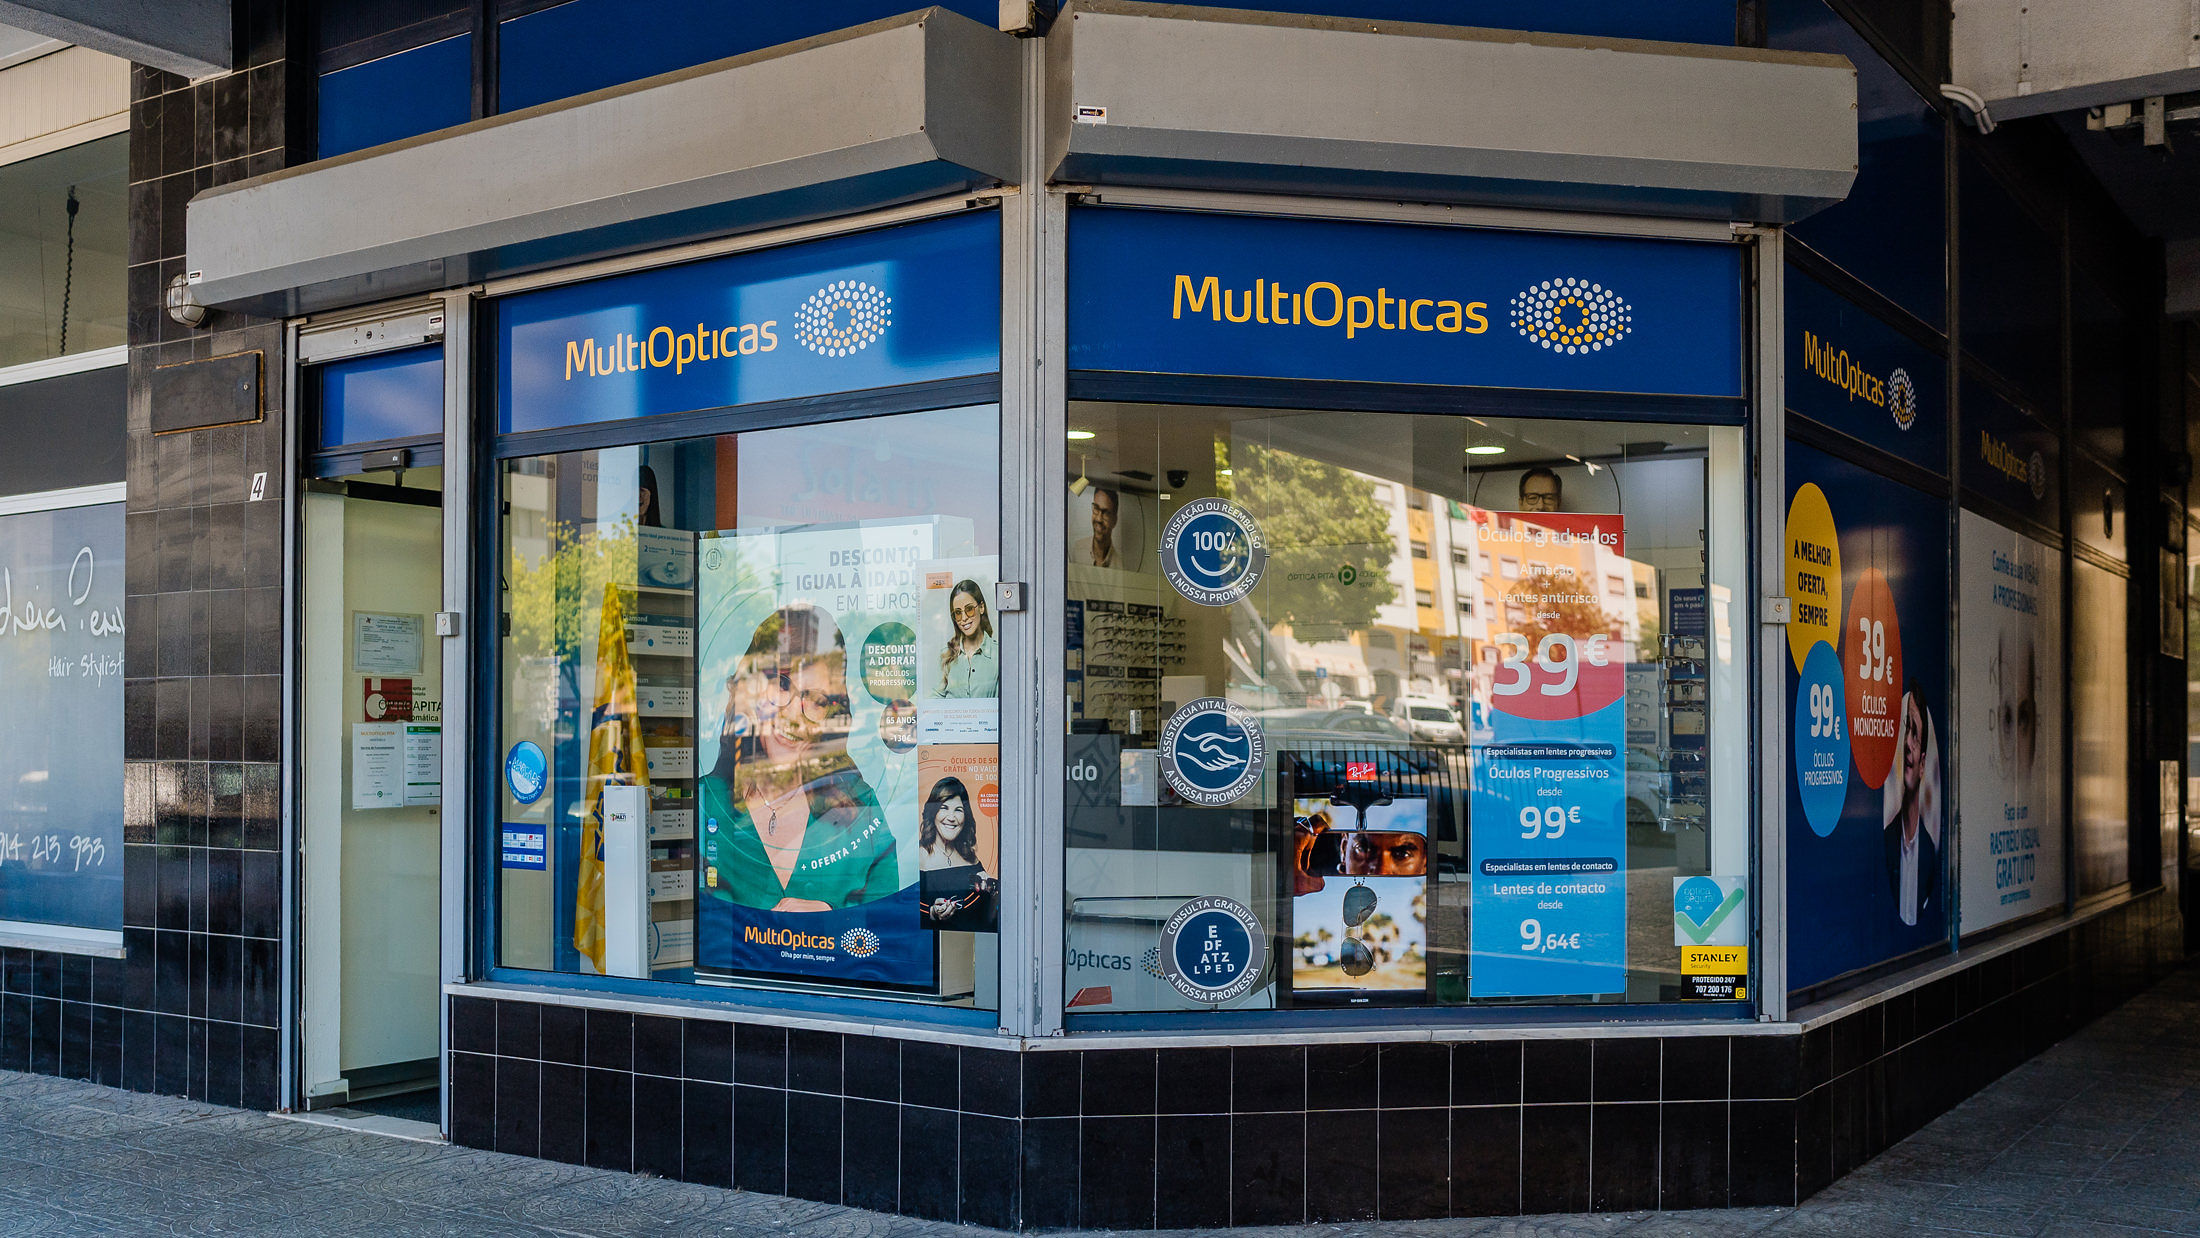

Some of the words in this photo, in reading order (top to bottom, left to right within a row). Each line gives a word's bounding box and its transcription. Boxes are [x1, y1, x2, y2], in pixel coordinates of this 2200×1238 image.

[1173, 274, 1489, 339] MultiOpticas
[565, 320, 778, 381] MultiOpticas
[1804, 330, 1885, 408] MultiOpticas
[1981, 430, 2028, 484] MultiOpticas
[252, 476, 264, 498] 4
[1165, 501, 1204, 549] SATISFAÇÃO
[1206, 502, 1220, 511] OU
[1221, 504, 1261, 549] REEMBOLSO
[1479, 523, 1531, 543] Óculos
[1534, 528, 1618, 548] graduados
[1192, 531, 1236, 551] 100%
[829, 546, 921, 567] DESCONTO
[1793, 539, 1801, 560] A
[1801, 541, 1832, 568] MELHOR
[796, 573, 847, 591] IGUAL
[851, 568, 863, 588] À
[1519, 563, 1574, 578] Armação
[1169, 572, 1178, 580] A
[1175, 578, 1207, 601] NOSSA
[1209, 572, 1258, 602] PROMESSA
[1798, 571, 1829, 601] OFERTA,
[836, 594, 860, 611] EM
[1498, 592, 1539, 604] Lentes
[1542, 591, 1599, 604] antirrisco
[1536, 611, 1561, 619] desde
[1798, 603, 1829, 628] SEMPRE
[868, 645, 916, 655] DESCONTO
[869, 657, 876, 665] A
[878, 656, 915, 666] DOBRAR
[49, 655, 74, 678] Hair
[80, 651, 125, 689] Stylist
[886, 668, 910, 677] ÓCULOS
[869, 679, 915, 687] PROGRESSIVOS
[1862, 691, 1888, 716] ÓCULOS
[896, 716, 916, 724] ANOS
[1853, 716, 1895, 739] MONOFOCAIS
[1163, 704, 1198, 759] ASSISTÊNCIA
[1198, 700, 1243, 718] VITALÍCIA
[1242, 717, 1263, 764] GRATUITA
[950, 756, 977, 764] ÓCULOS
[1486, 747, 1532, 757] Especialistas
[1545, 747, 1567, 756] lentes
[1568, 748, 1613, 757] progressivas
[1813, 748, 1835, 769] ÓCULOS
[943, 764, 967, 772] GRÁTIS
[1489, 765, 1531, 779] Óculos
[1533, 767, 1609, 781] Progressivos
[1804, 761, 1844, 786] PROGRESSIVOS
[1166, 770, 1175, 778] A
[1171, 777, 1203, 802] NOSSA
[1205, 774, 1257, 802] PROMESSA
[1537, 786, 1562, 796] desde
[1519, 805, 1581, 839] 99€
[32, 834, 60, 864] 213
[69, 835, 105, 872] 933
[811, 847, 850, 870] OFERTA
[862, 817, 882, 840] PAR
[1485, 862, 1534, 872] Especialistas
[1547, 862, 1570, 871] lentes
[1571, 862, 1581, 870] de
[1582, 861, 1613, 870] contacto
[1996, 854, 2036, 890] GRATUITO
[1493, 882, 1534, 896] Lentes
[1537, 882, 1552, 896] de
[1555, 882, 1606, 895] contacto
[1537, 899, 1563, 910] desde
[1167, 899, 1211, 935] CONSULTA
[1214, 899, 1256, 930] GRATUITA
[744, 926, 835, 951] MultiOpticas
[1208, 925, 1218, 939] E
[1520, 918, 1581, 954] 9,64€
[780, 951, 793, 959] Olha
[793, 953, 802, 961] por
[802, 952, 815, 962] mim,
[816, 954, 836, 963] sempre
[1690, 953, 1738, 962] STANLEY
[1168, 973, 1177, 981] A
[1175, 978, 1207, 1001] NOSSA
[1210, 967, 1259, 1001] PROMESSA
[1692, 976, 1724, 984] PROTEGIDO
[1724, 976, 1736, 984] 24/7
[1695, 985, 1707, 993] 707
[1708, 985, 1720, 993] 200
